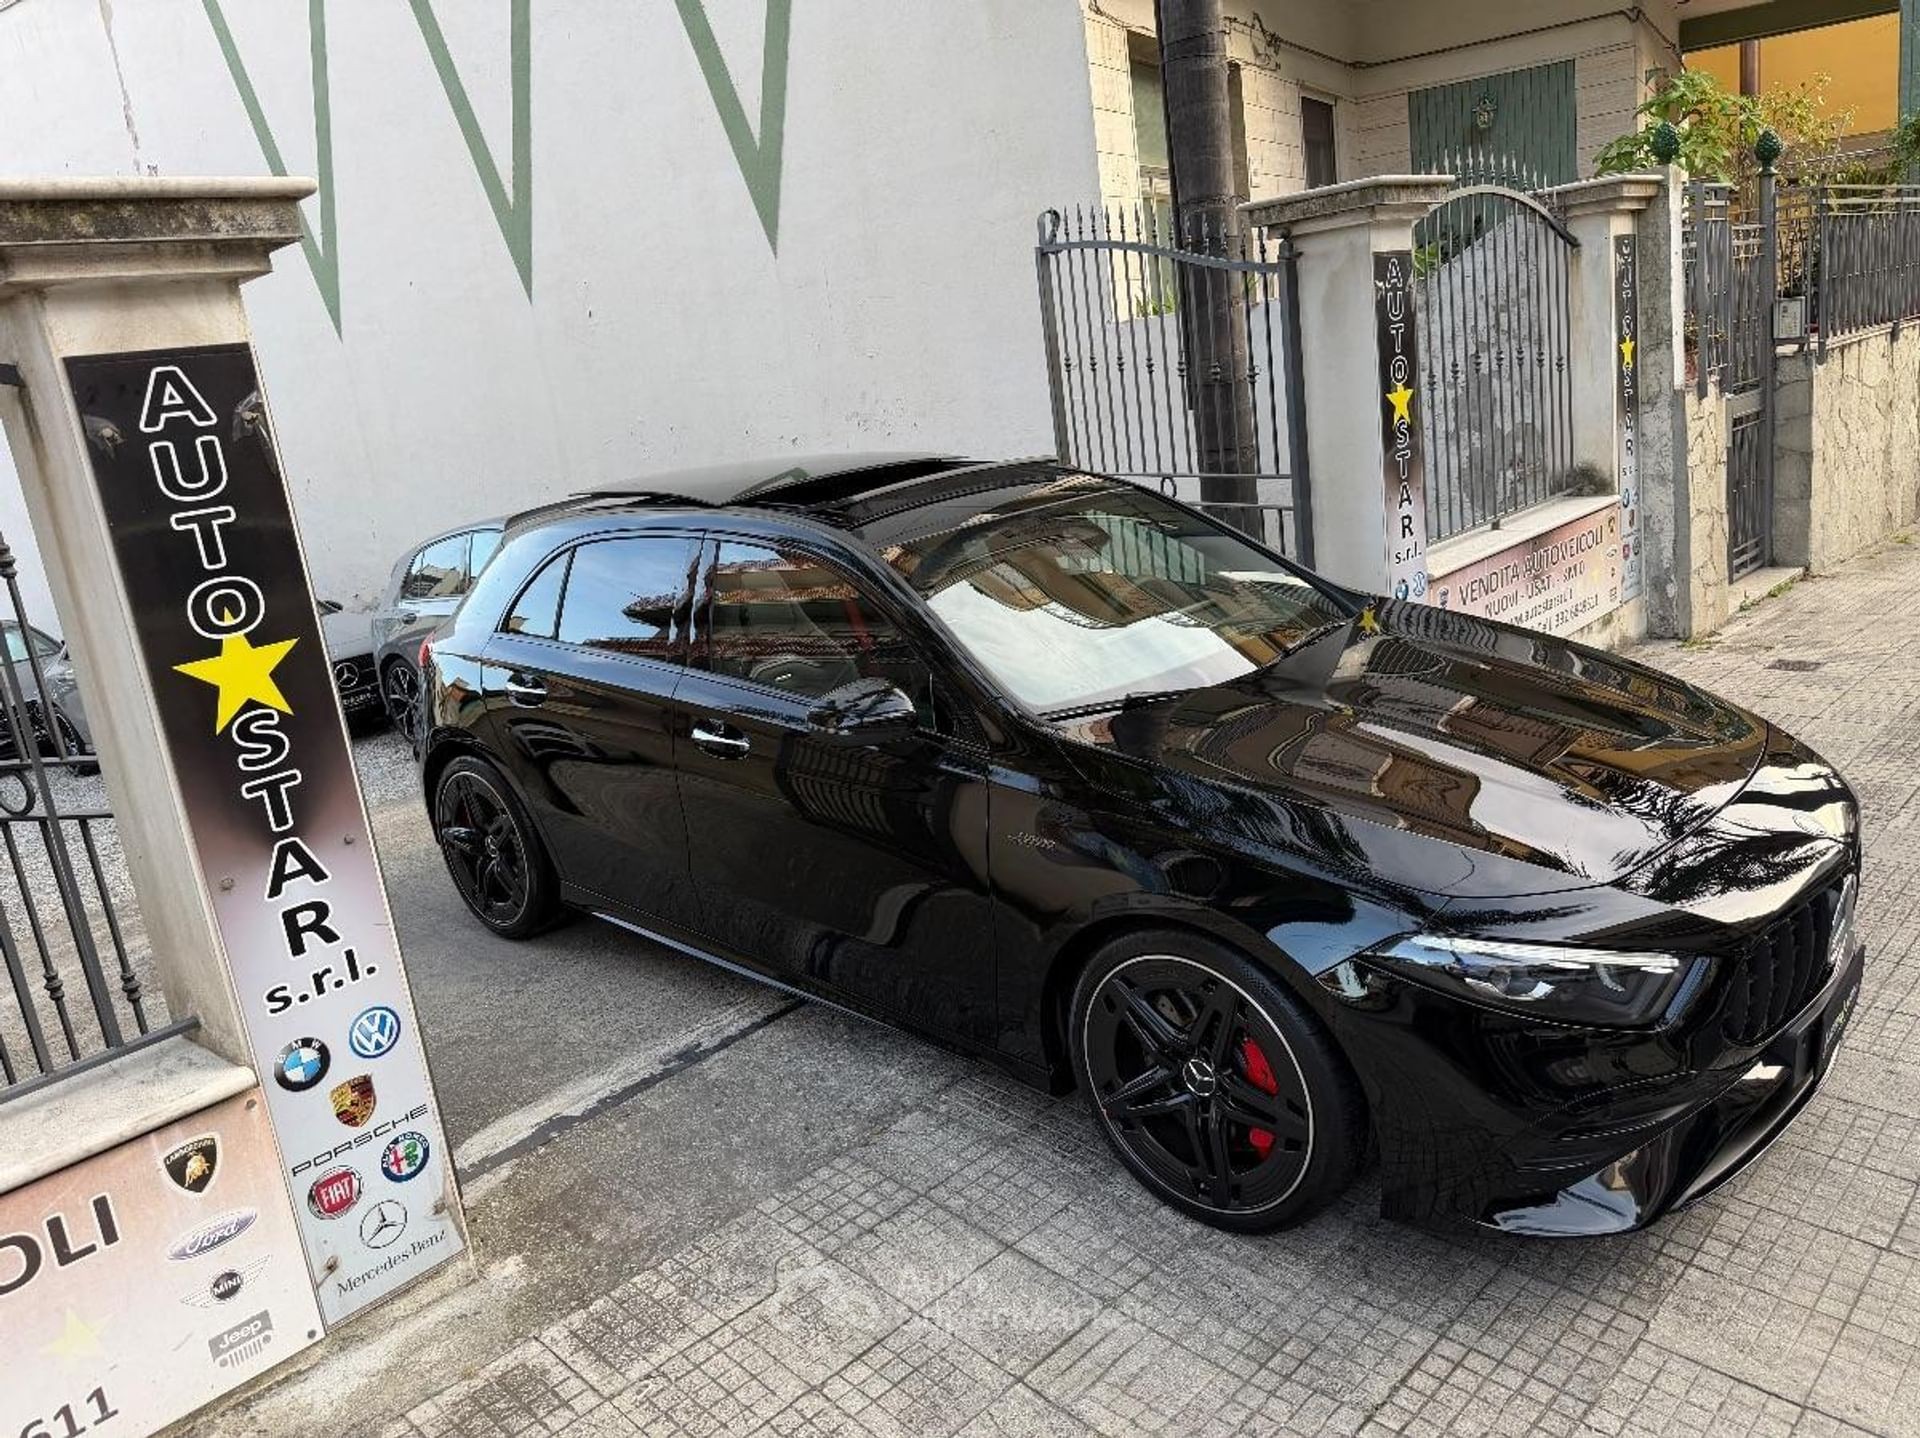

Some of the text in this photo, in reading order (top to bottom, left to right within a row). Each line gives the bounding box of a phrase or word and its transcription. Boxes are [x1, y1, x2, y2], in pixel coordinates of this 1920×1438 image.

[1385, 257, 1409, 385] AUTO
[139, 366, 265, 640] AUTO
[1394, 419, 1414, 539] STAR
[1395, 540, 1422, 565] s.r.l.
[1459, 561, 1520, 606] VENDITA
[1523, 525, 1604, 578] AUTOVEICOLI
[230, 708, 341, 959] STAR
[265, 947, 378, 1015] s.r.l.
[275, 1036, 322, 1064] BMW
[291, 1103, 429, 1177] PORSCHE
[319, 1176, 352, 1209] FIAT
[185, 1217, 240, 1252] Ford
[212, 1275, 242, 1297] MINI
[218, 1319, 263, 1350] Jeep
